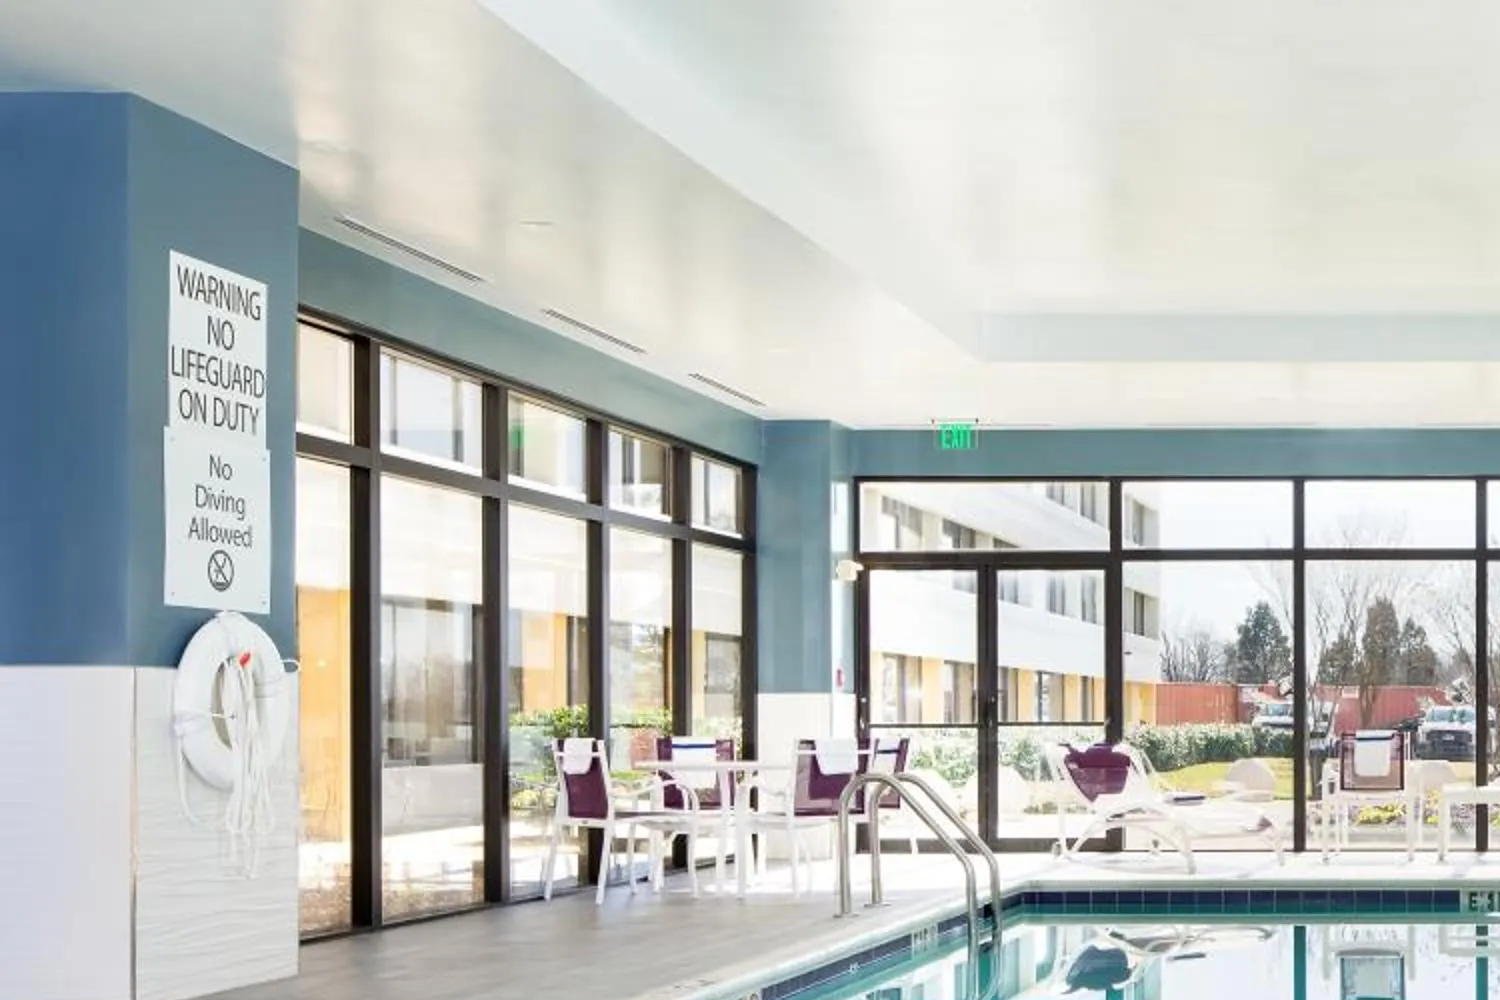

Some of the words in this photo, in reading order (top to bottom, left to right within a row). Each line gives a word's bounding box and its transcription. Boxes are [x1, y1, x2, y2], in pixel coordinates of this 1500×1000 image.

[176, 264, 262, 321] WARNING
[207, 315, 236, 351] NO
[171, 345, 265, 399] LIFEGUARD
[179, 389, 207, 425] ON
[213, 397, 260, 436] DUTY
[208, 455, 233, 481] No
[195, 484, 247, 521] Diving
[188, 516, 253, 549] Allowed
